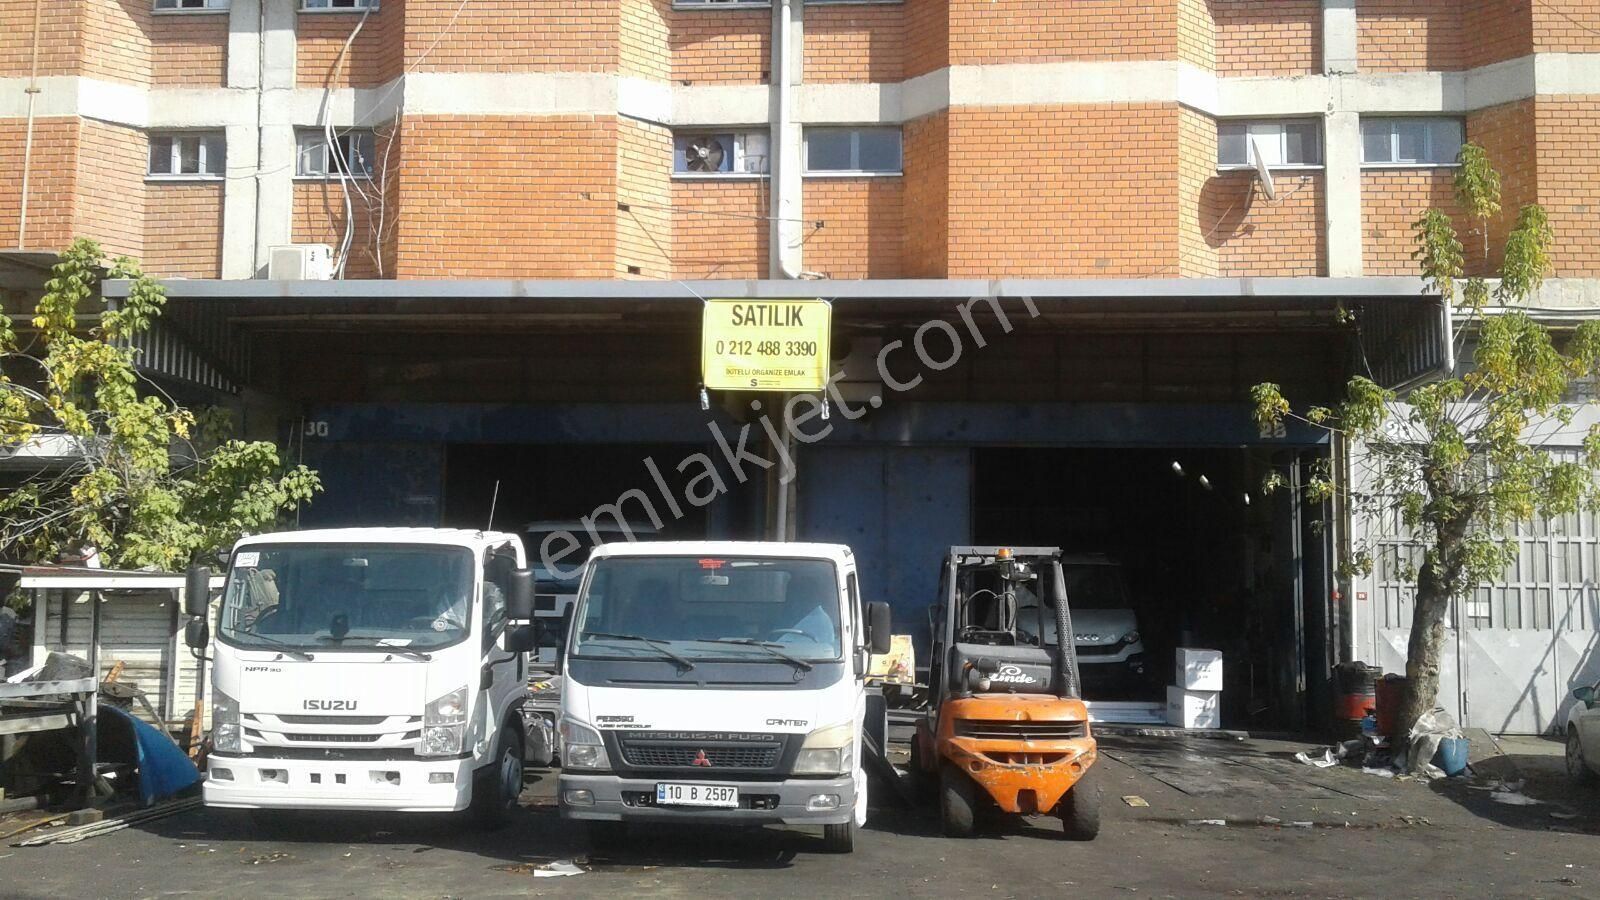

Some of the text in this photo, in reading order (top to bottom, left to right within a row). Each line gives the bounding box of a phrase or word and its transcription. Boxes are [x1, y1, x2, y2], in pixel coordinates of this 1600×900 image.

[731, 304, 804, 327] SATILIK
[716, 340, 817, 357] 0 212 488 3390
[783, 369, 806, 377] EMLAK
[305, 421, 329, 437] 30
[989, 665, 1037, 684] Linde
[303, 699, 358, 711] ISUZU
[766, 718, 808, 727] CANTER
[728, 732, 775, 742] FUSO
[668, 785, 735, 801] 10 B 2587
